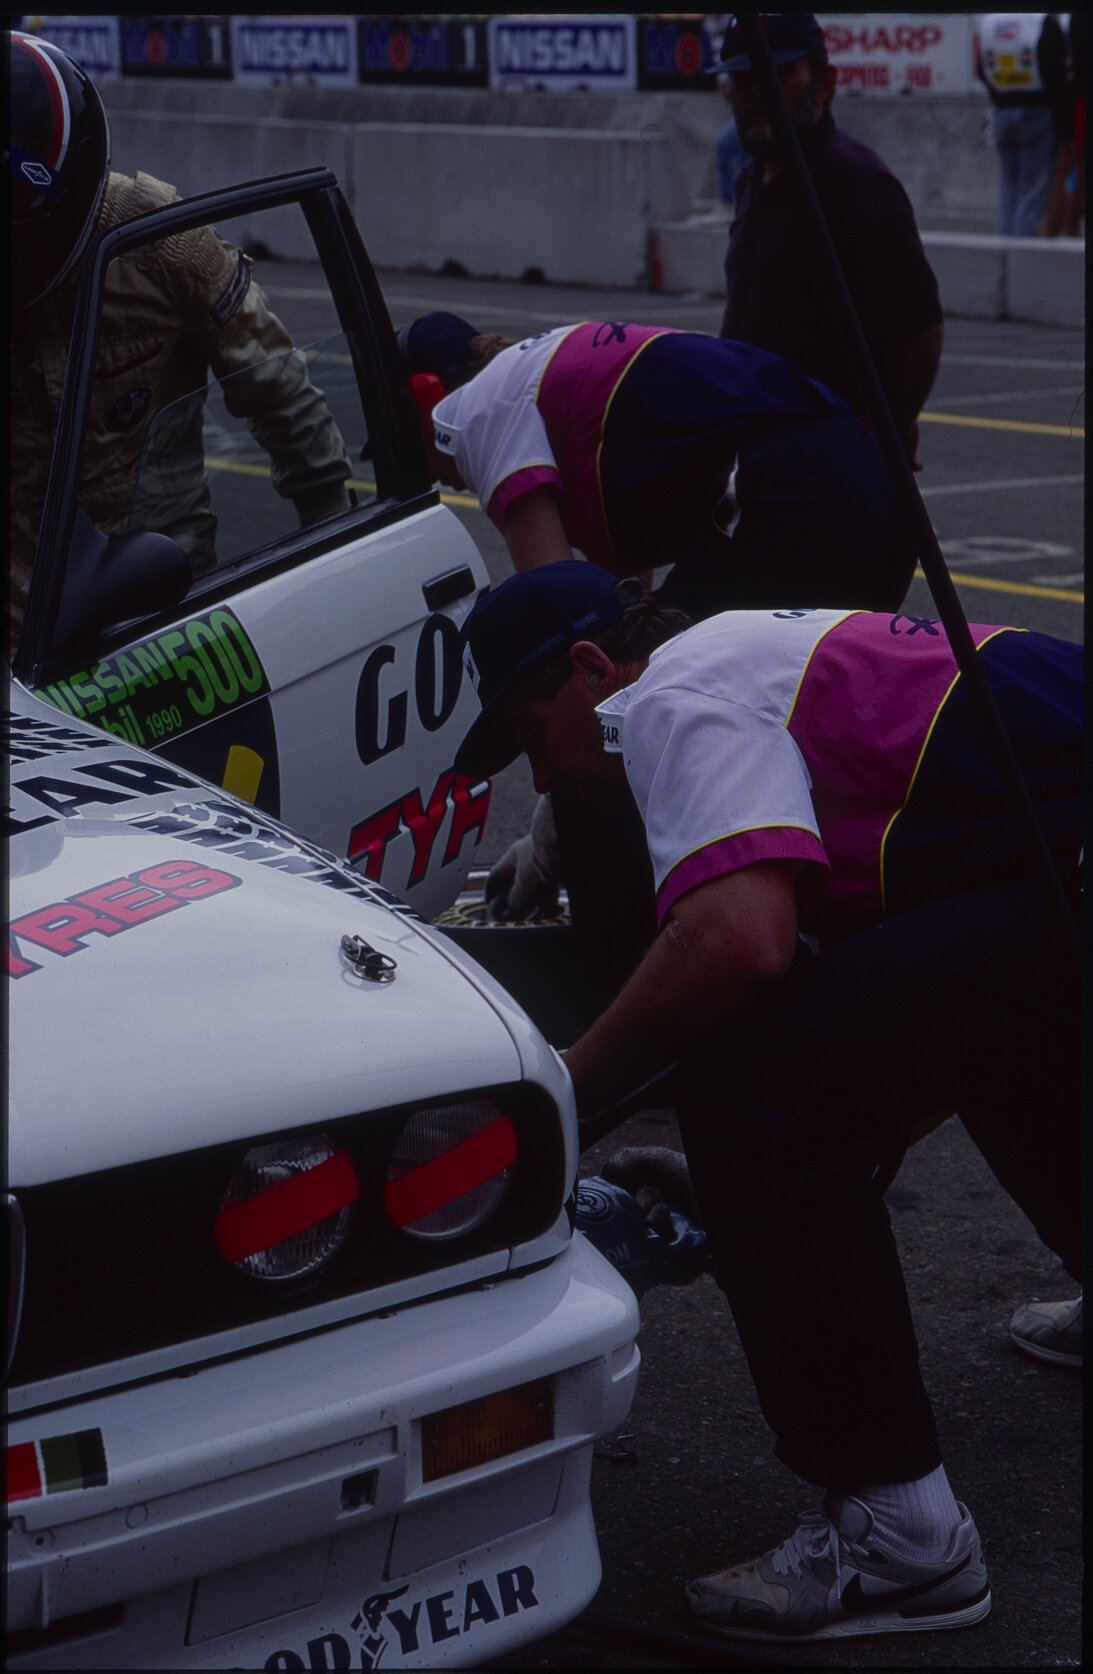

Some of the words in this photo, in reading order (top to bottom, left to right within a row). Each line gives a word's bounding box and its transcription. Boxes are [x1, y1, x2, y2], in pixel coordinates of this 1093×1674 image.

[209, 24, 224, 67] 1
[243, 29, 346, 67] NISSAN
[364, 23, 450, 71] Mobil
[463, 25, 477, 70] 1
[500, 29, 622, 69] NISSAN
[824, 25, 941, 53] SHARP
[436, 431, 451, 446] AR
[35, 633, 175, 718] NISSAN
[157, 610, 263, 716] 500
[100, 704, 147, 745] bil
[145, 704, 183, 740] 1990
